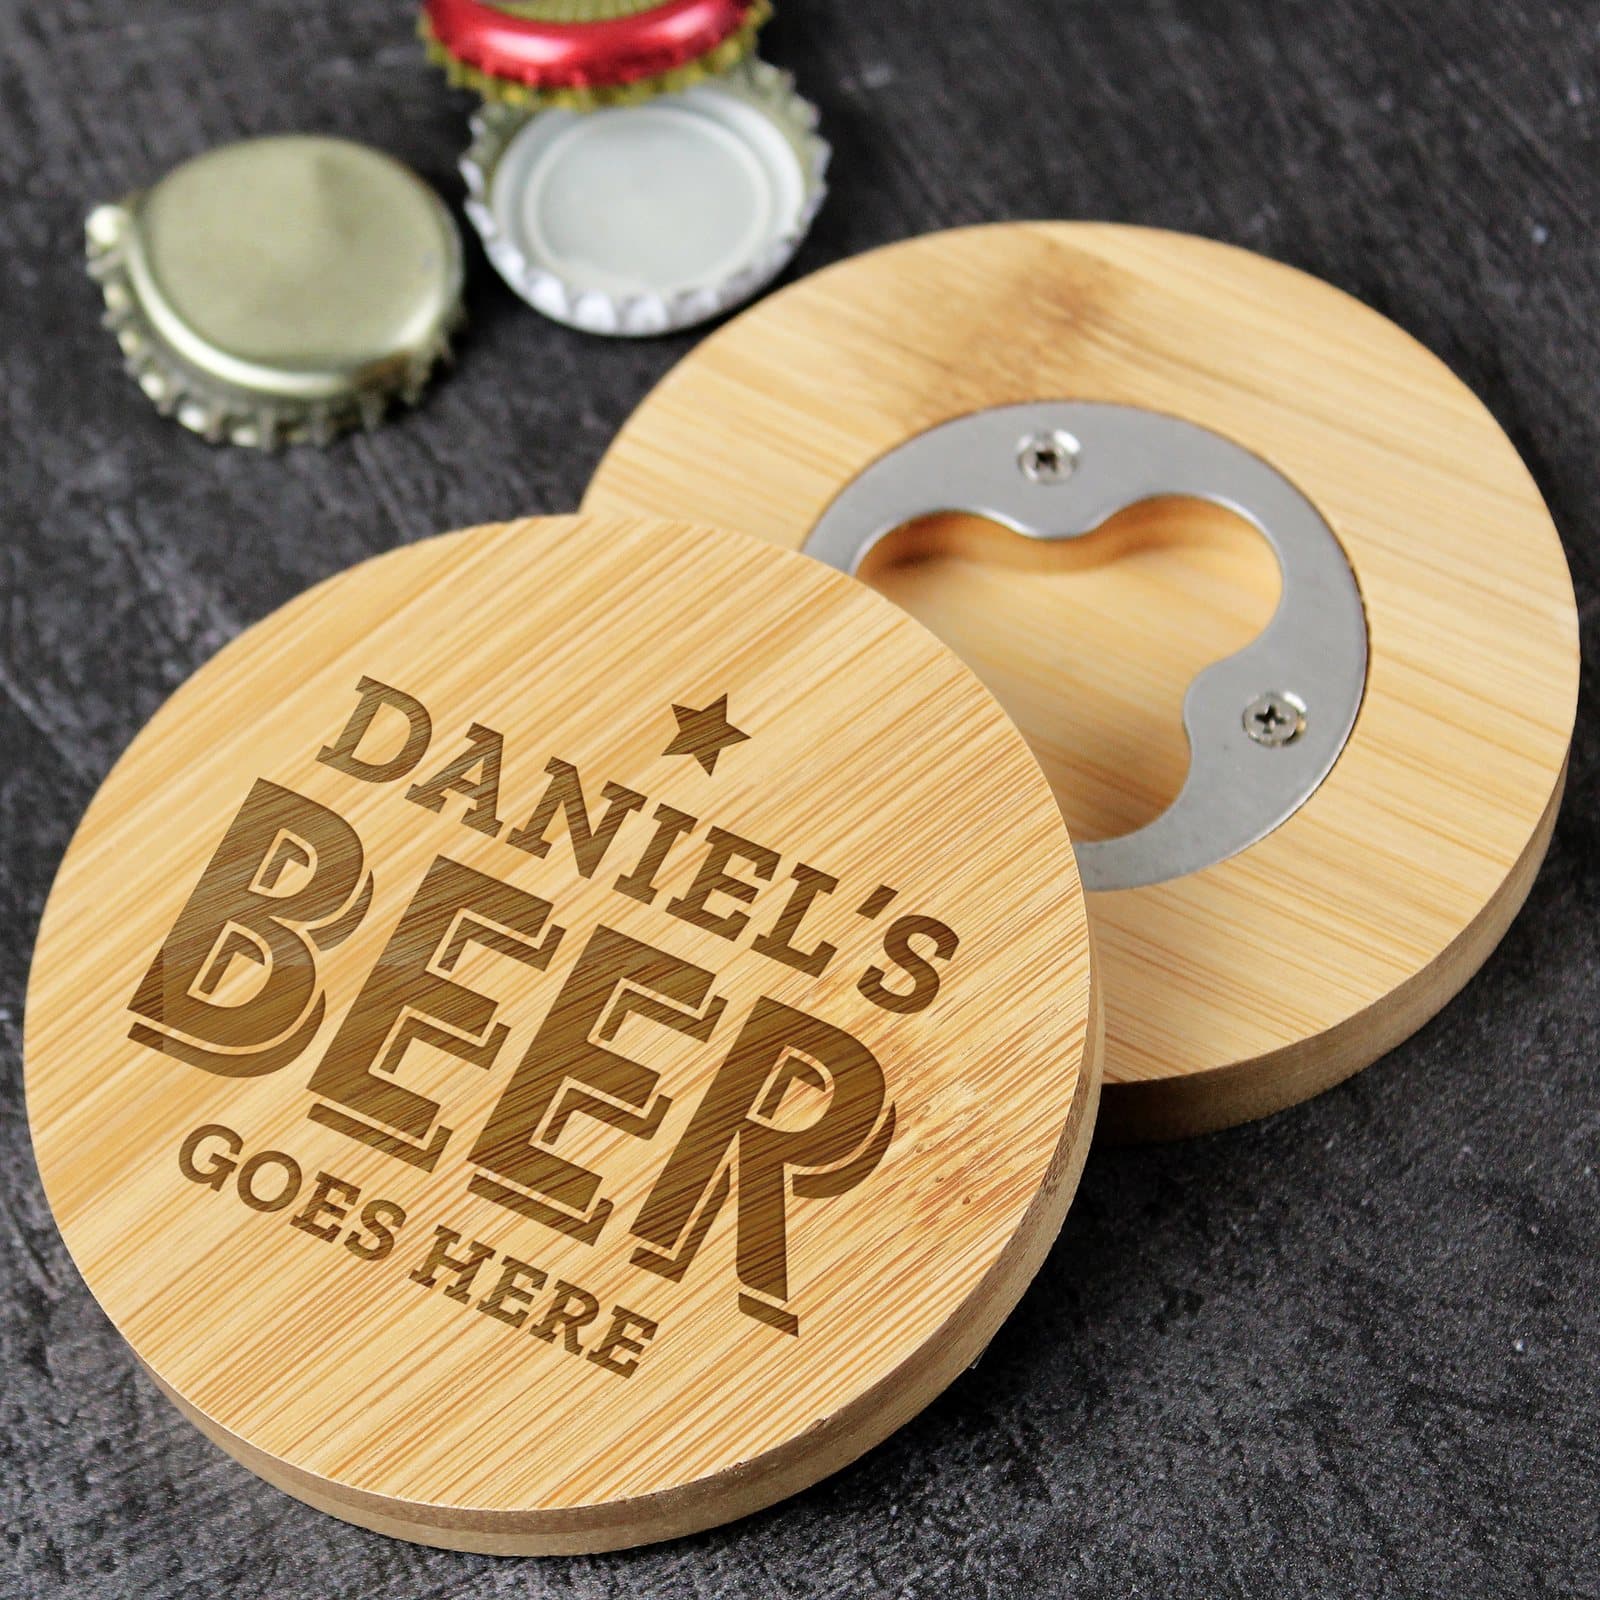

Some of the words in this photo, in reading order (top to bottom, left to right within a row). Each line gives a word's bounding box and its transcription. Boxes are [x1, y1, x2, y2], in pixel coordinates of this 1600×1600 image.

[317, 675, 960, 1015] DANIEL'S
[127, 777, 898, 1337] BEER
[179, 1123, 407, 1262] GOES
[409, 1225, 659, 1378] HERE
